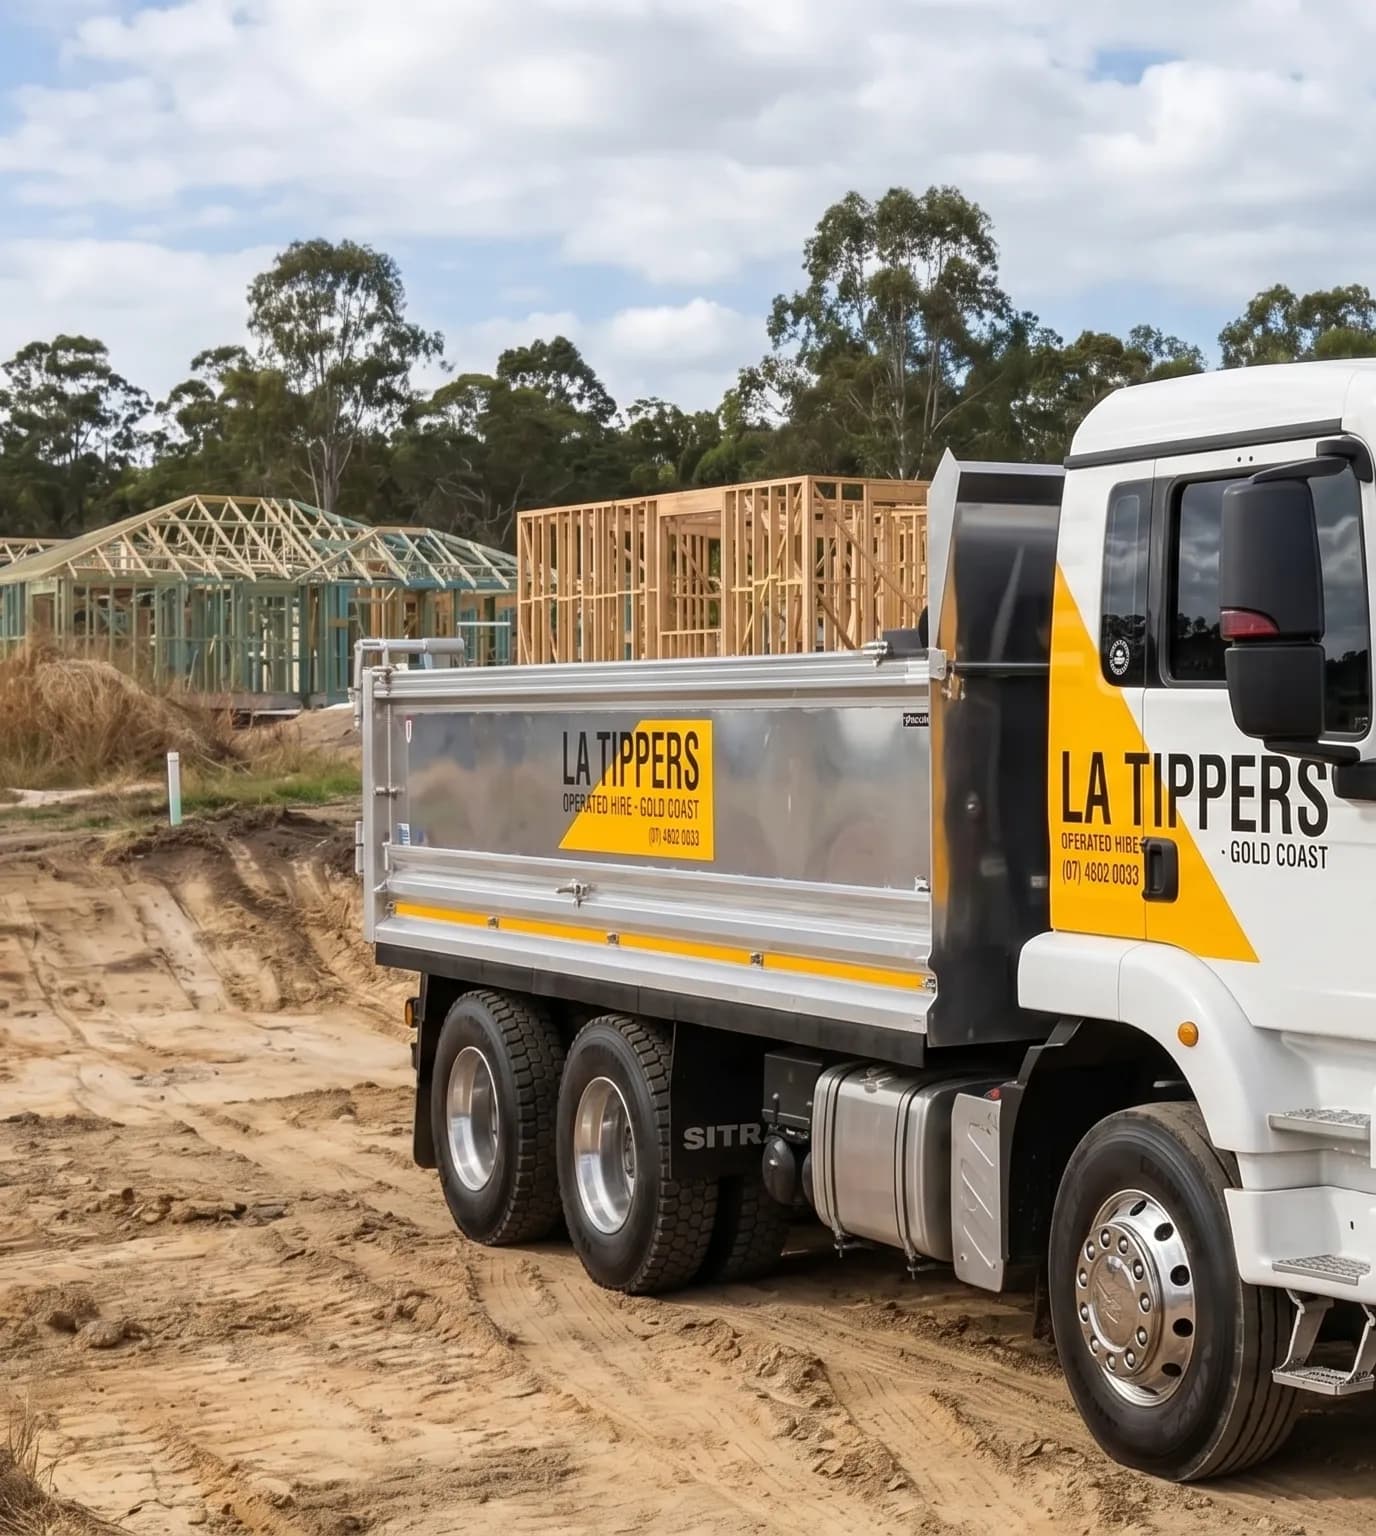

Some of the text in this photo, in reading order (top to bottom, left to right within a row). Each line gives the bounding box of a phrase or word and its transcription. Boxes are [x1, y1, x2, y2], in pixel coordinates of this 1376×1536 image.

[563, 731, 699, 791] LA TIPPERS
[563, 793, 608, 814] OPERATED
[611, 796, 632, 816] HIRE
[640, 797, 665, 818] GOLD
[668, 798, 699, 819] COAST
[1062, 750, 1328, 837] LA TIPPERS
[1231, 840, 1270, 865] GOLD
[1276, 843, 1328, 869] COAST
[1062, 859, 1139, 886] (07) 4802 0033
[683, 1123, 768, 1150] SITR
